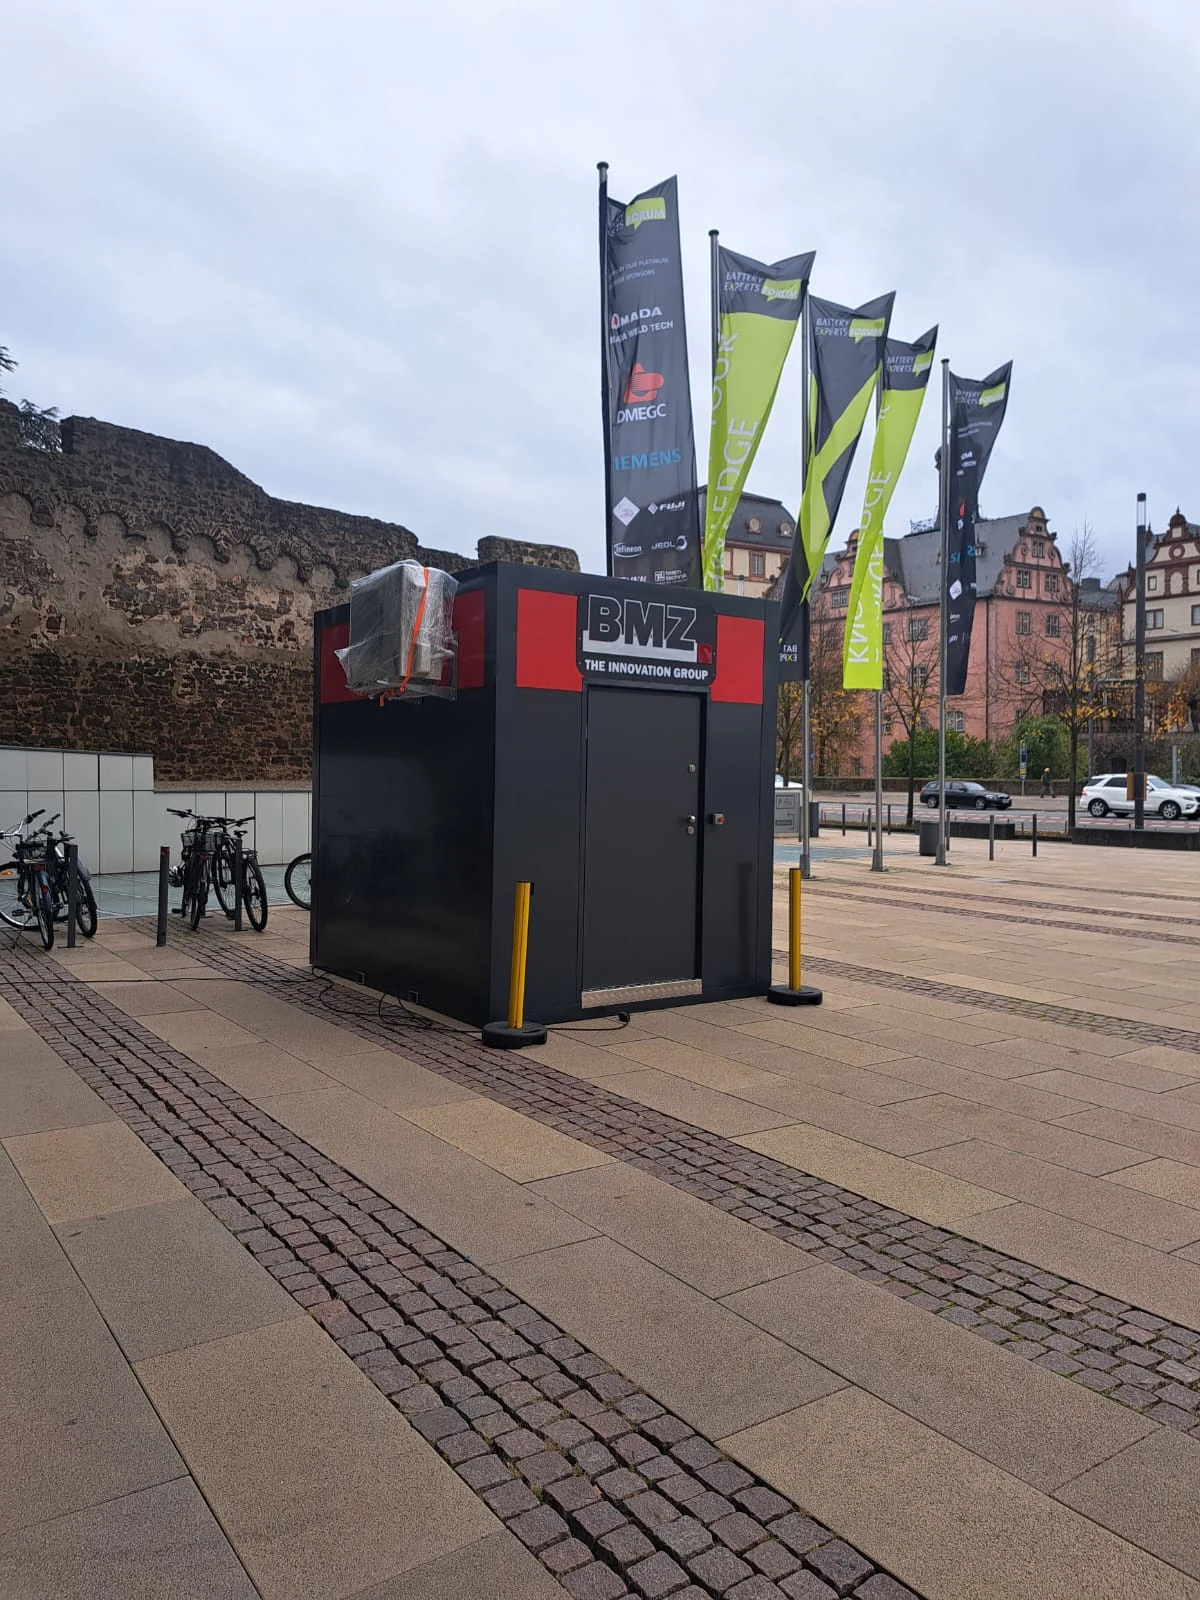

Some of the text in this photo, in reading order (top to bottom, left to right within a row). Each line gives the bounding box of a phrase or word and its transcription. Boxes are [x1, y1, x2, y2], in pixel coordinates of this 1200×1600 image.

[726, 271, 764, 284] BATTERY
[724, 281, 760, 293] EXPERTS
[650, 320, 674, 332] TECH
[816, 317, 850, 327] BATTERY
[815, 326, 848, 337] EXPERTS
[617, 403, 666, 424] DMEGC
[613, 447, 681, 471] IEMENS
[659, 500, 685, 511] FUJI
[586, 594, 697, 652] BMZ
[584, 659, 708, 680] THE INNOVATION GROUP
